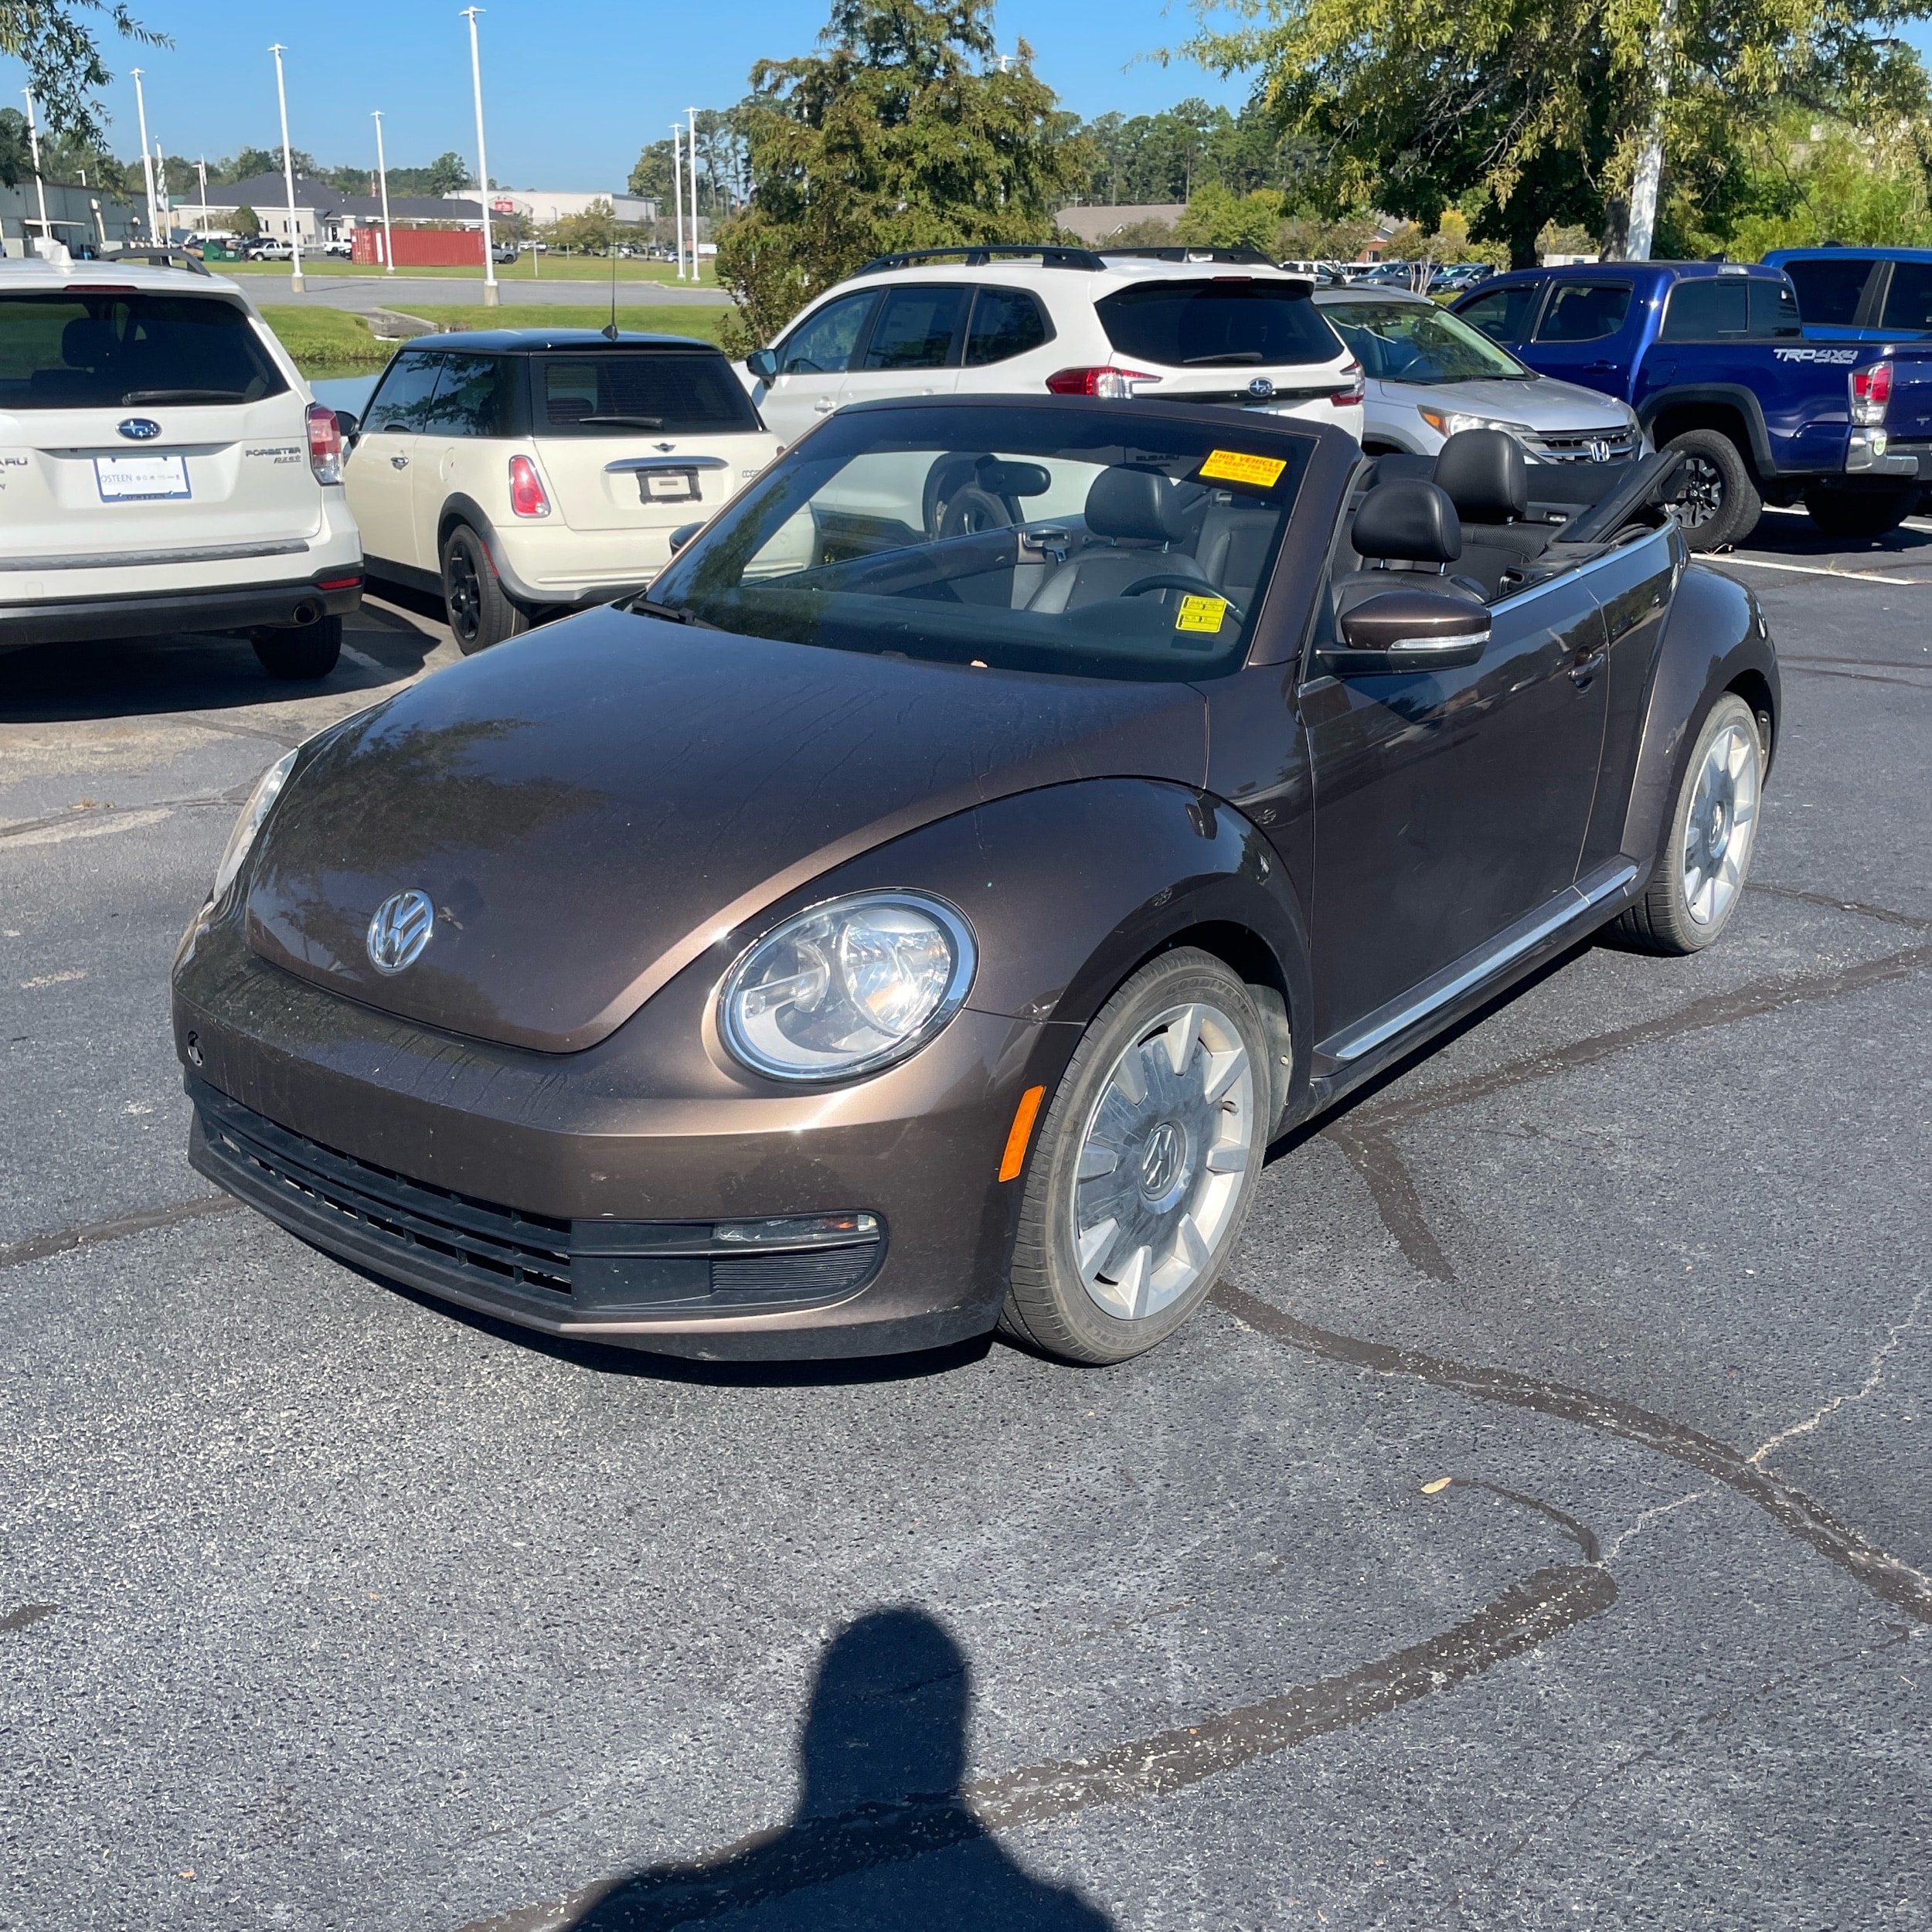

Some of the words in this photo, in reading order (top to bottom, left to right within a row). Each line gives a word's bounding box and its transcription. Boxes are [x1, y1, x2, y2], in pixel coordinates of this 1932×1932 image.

[1774, 349, 1816, 362] TRD
[245, 447, 301, 457] FORESTER
[1135, 452, 1179, 462] SUBARU
[1214, 452, 1236, 461] THIS
[1240, 456, 1282, 469] VEHICLE
[100, 474, 133, 483] OSTEEN
[1166, 978, 1250, 1014] GOODYEAR
